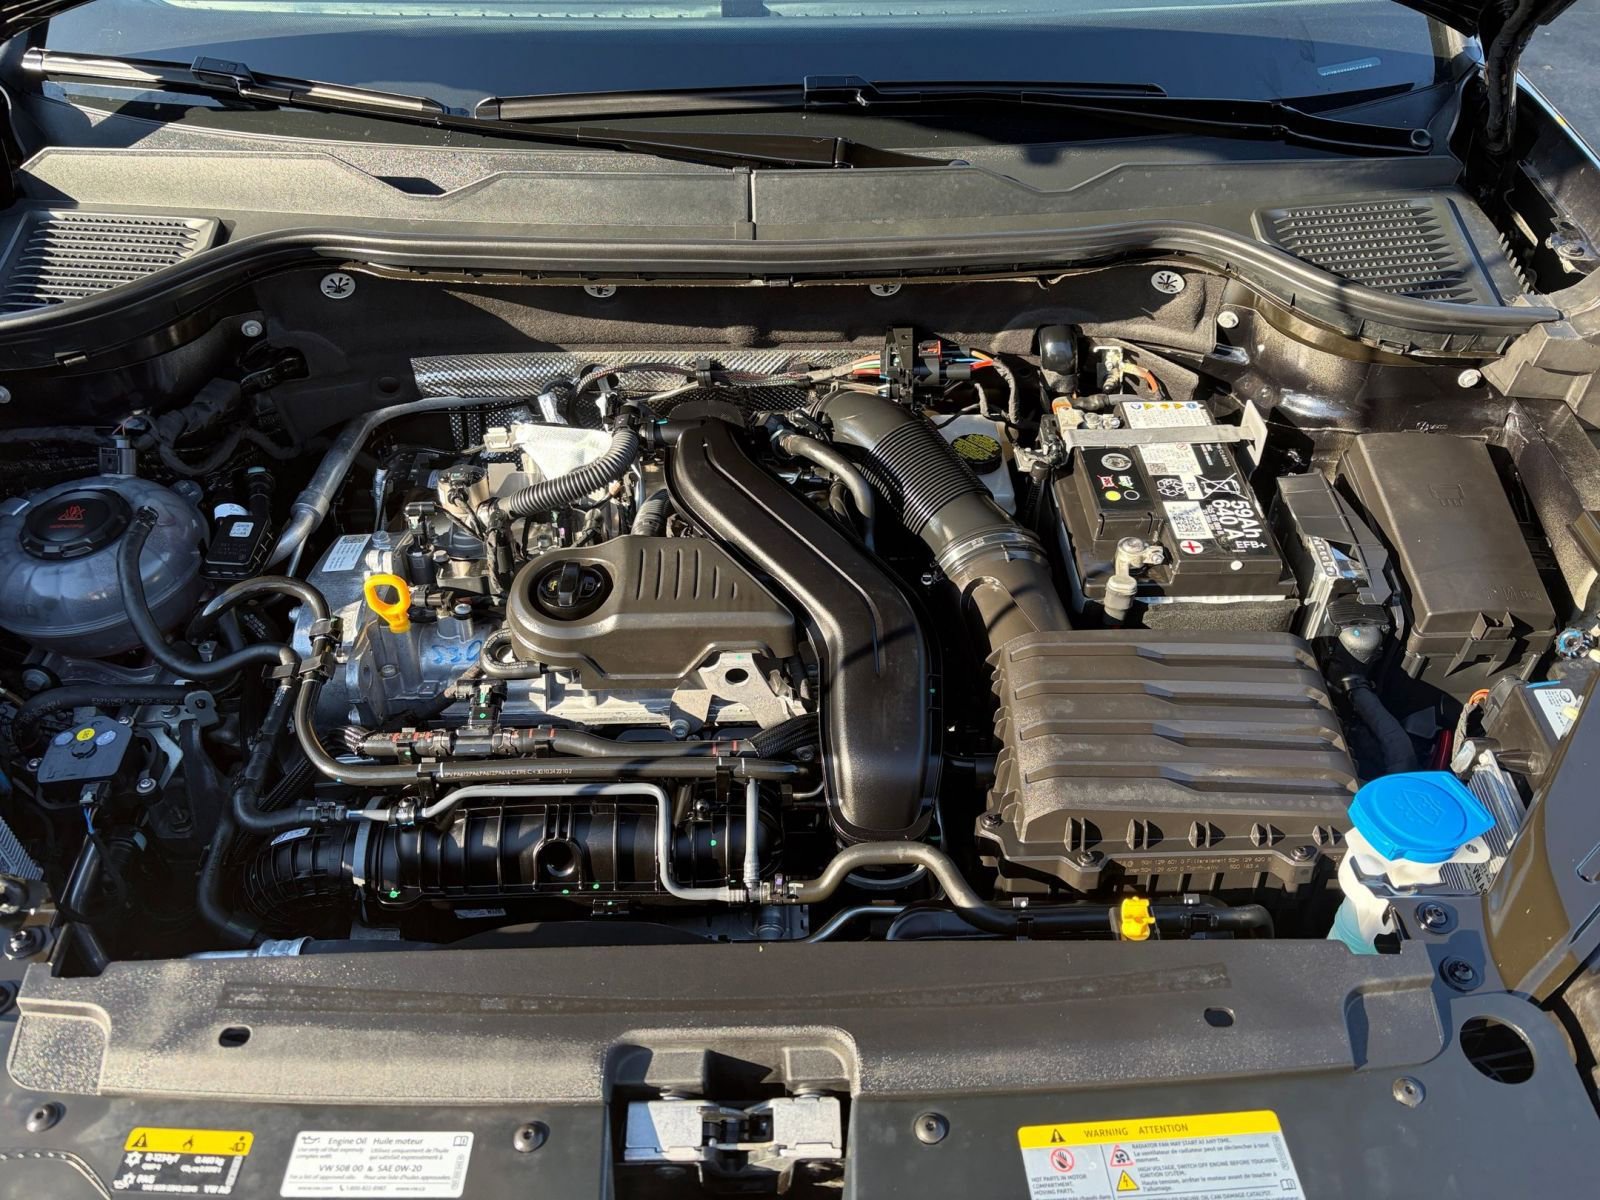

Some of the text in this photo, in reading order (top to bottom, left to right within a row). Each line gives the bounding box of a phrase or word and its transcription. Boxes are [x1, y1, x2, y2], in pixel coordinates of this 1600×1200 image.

[1211, 499, 1239, 525] 640
[1230, 499, 1263, 538] 59Ah
[1235, 540, 1268, 549] EFB+
[1083, 1122, 1189, 1138] WARNING ATTENTION
[327, 1137, 368, 1147] Engine Oil
[373, 1137, 394, 1145] Huile
[319, 1164, 333, 1172] VW
[377, 1164, 393, 1172] SAE
